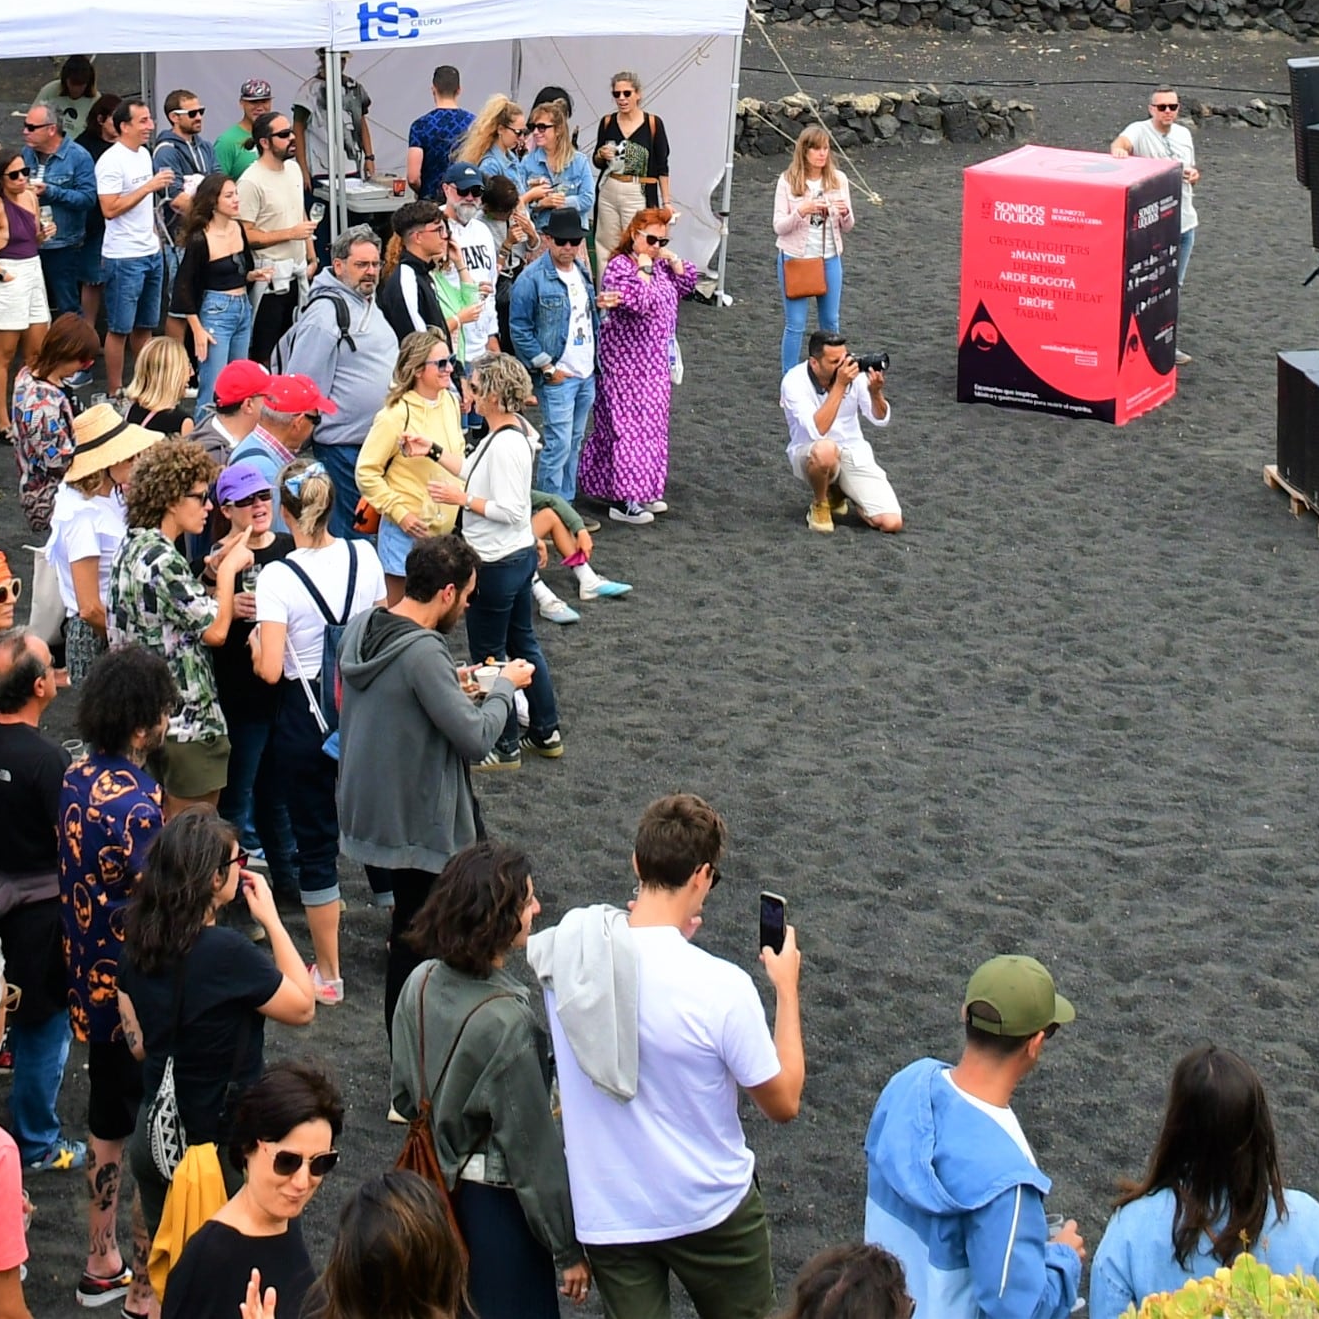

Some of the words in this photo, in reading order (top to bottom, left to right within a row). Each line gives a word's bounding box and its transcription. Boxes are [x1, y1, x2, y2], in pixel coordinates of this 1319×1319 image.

[410, 17, 442, 28] GRUPO
[994, 201, 1045, 217] SONIDOS
[989, 236, 1035, 249] CRYSTAL
[1036, 241, 1090, 256] FIGHTERS
[461, 245, 491, 271] ANS
[1011, 250, 1066, 264] 2MANYDJS
[1013, 262, 1063, 275] DEPEDRO
[999, 271, 1028, 283] ARDE
[1030, 274, 1076, 290] BOGOTÁ
[974, 279, 1022, 294] MIRANDA
[1025, 286, 1049, 297] AND
[1051, 289, 1073, 300] THE
[1076, 292, 1103, 304] BEAT
[1014, 307, 1058, 321] TABAIBA
